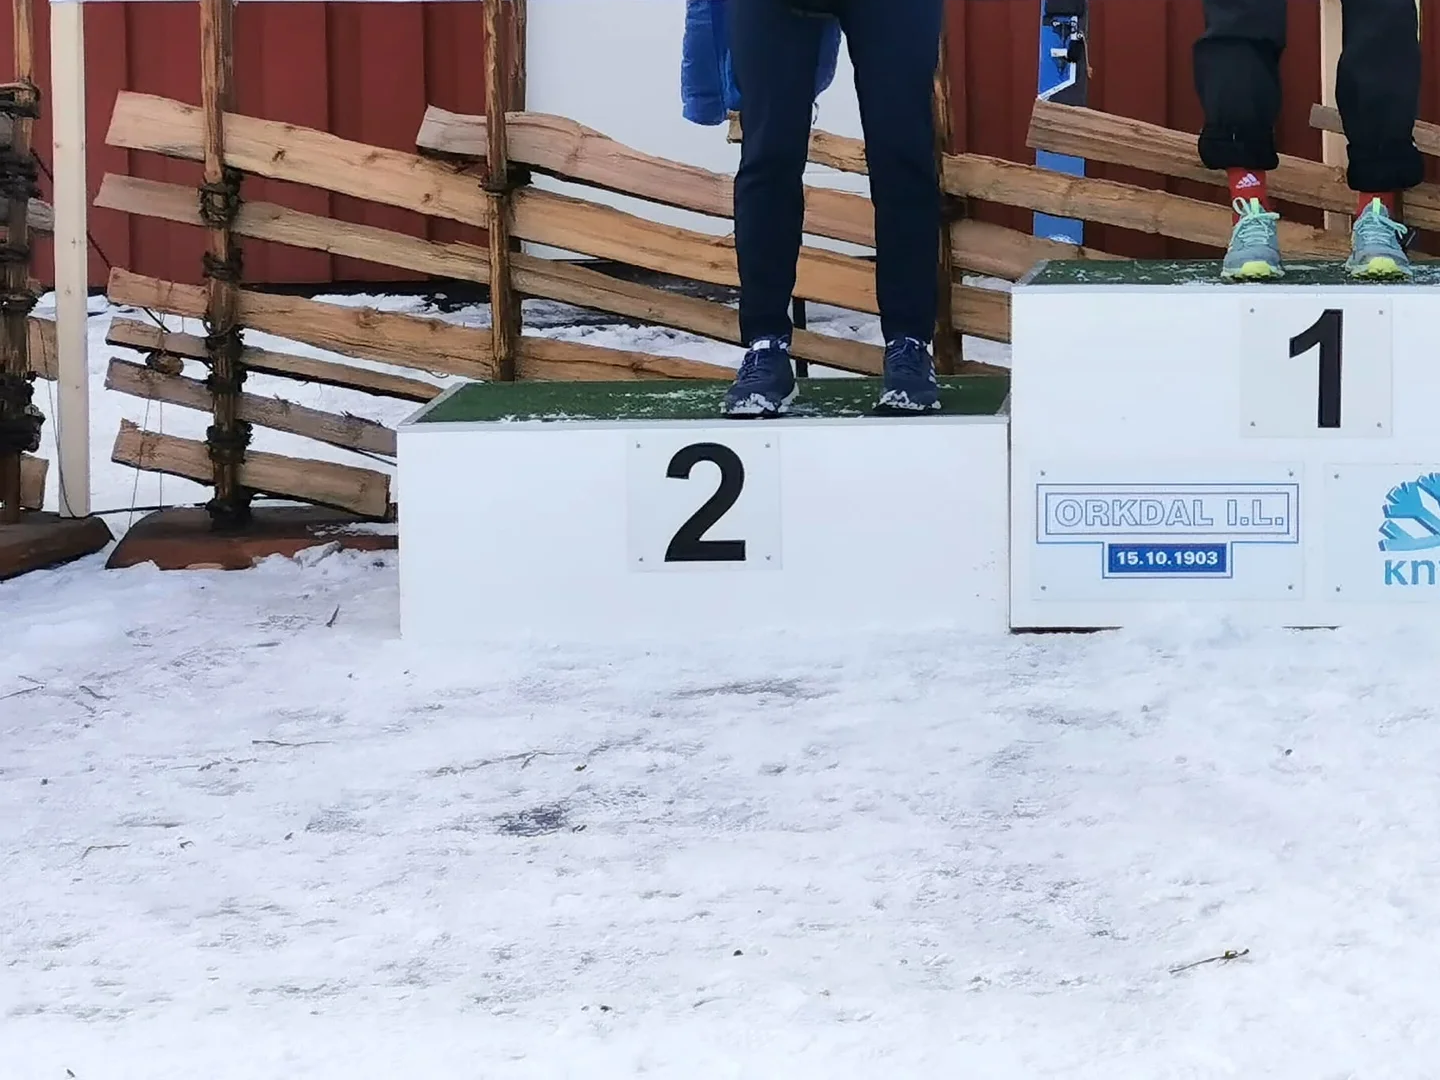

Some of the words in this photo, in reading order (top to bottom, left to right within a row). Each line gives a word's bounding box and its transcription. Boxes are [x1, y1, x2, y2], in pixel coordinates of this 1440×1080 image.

[1289, 308, 1343, 428] 1
[664, 442, 746, 562] 2
[1055, 498, 1213, 527] ORKDAL
[1227, 498, 1284, 527] I.L.
[1116, 550, 1219, 567] 15.10.1903
